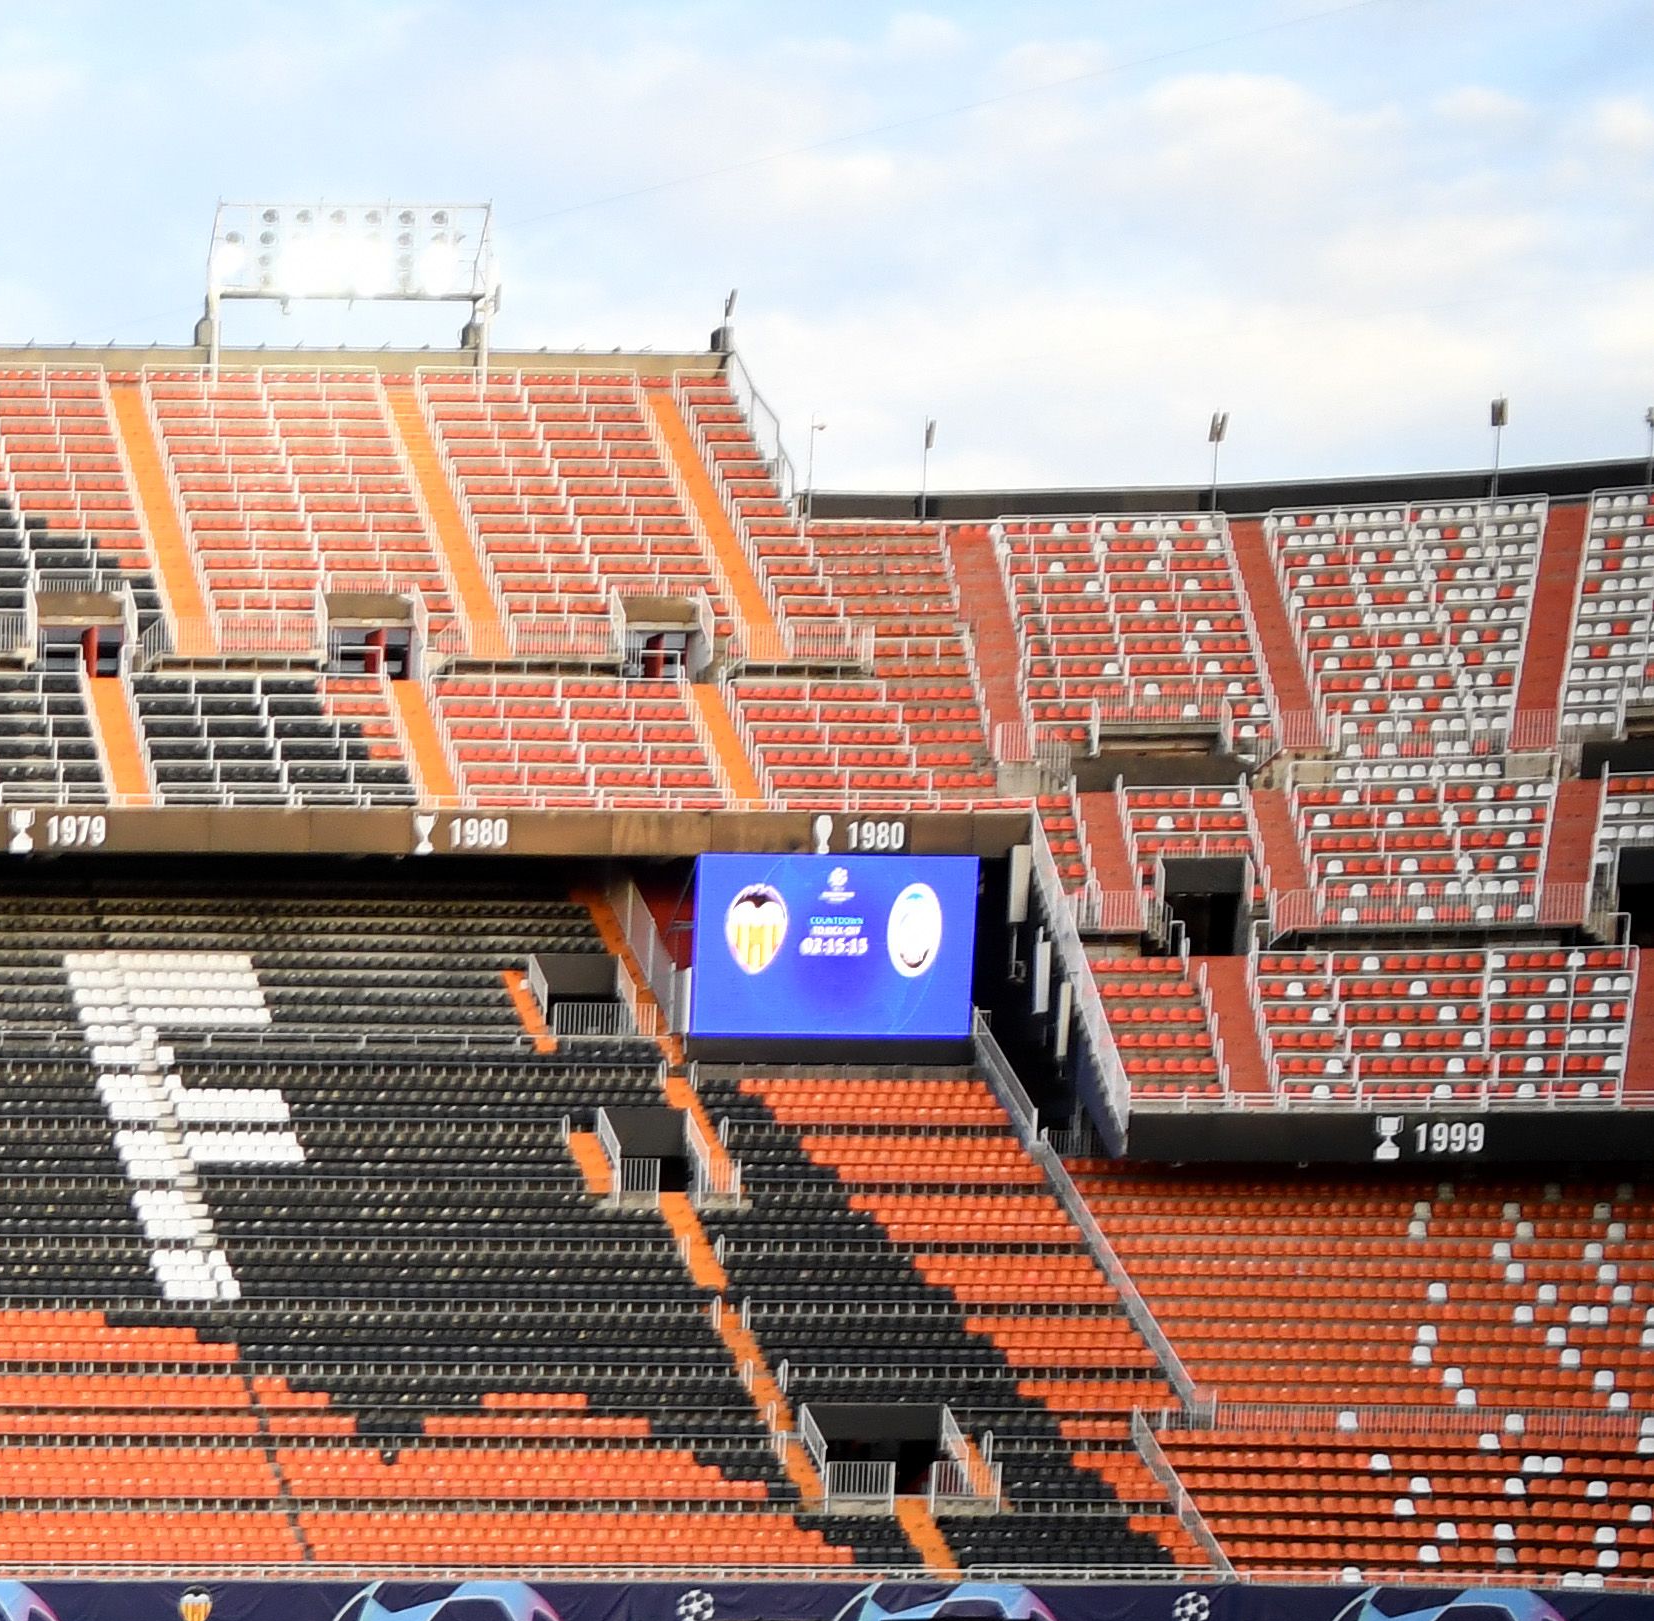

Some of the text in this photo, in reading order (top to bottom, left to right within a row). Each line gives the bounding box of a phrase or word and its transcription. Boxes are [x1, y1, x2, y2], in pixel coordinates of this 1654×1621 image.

[45, 815, 106, 847] 1979
[448, 818, 508, 848] 1980
[847, 821, 905, 851] 1980
[1414, 1121, 1485, 1154] 1999
